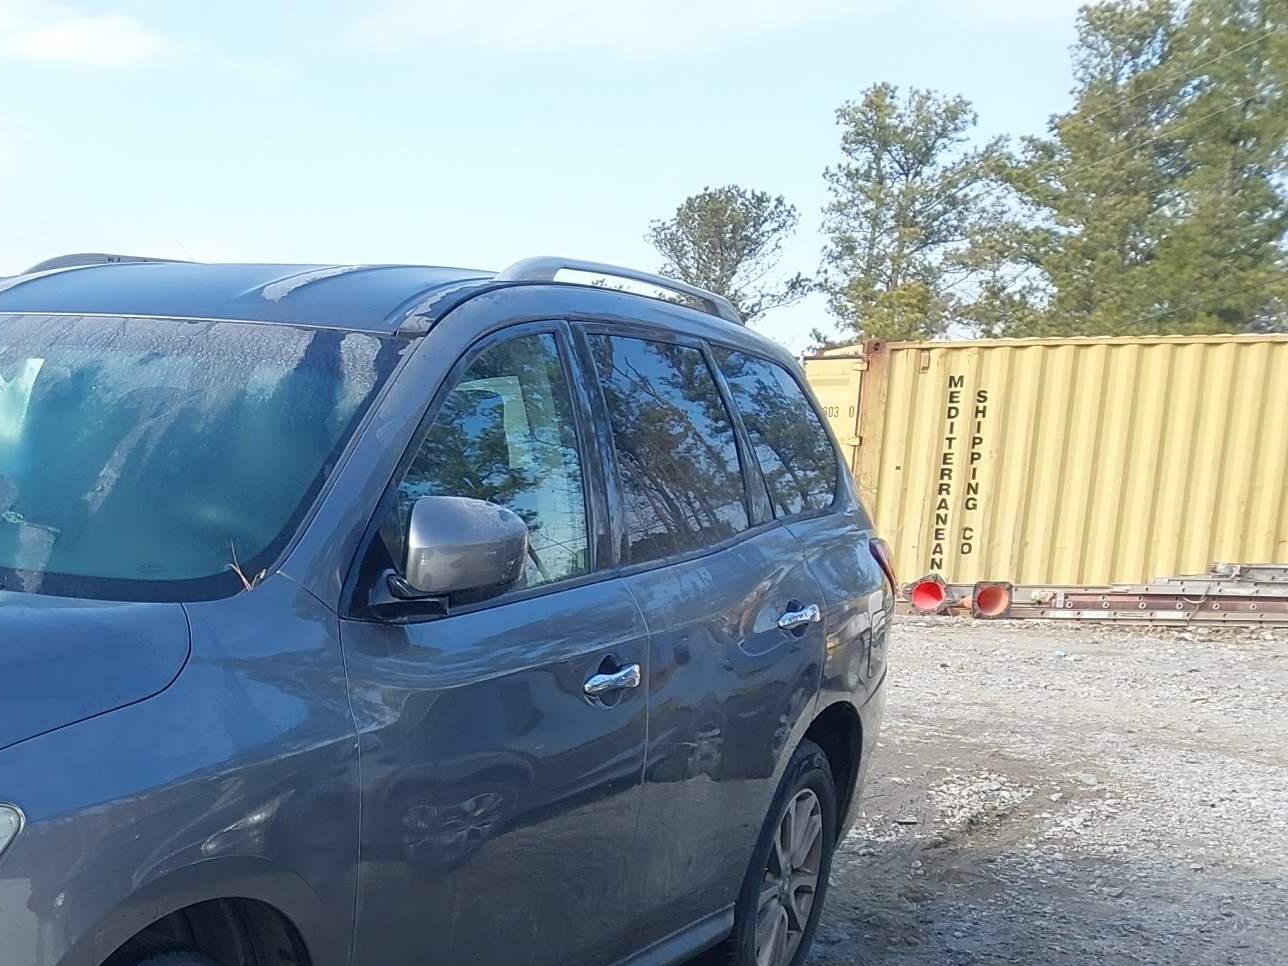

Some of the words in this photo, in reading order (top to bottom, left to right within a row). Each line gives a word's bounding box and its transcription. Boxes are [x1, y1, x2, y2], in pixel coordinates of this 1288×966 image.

[930, 375, 964, 570] MEDITERRANEAN
[965, 390, 988, 511] SHIPPING
[961, 527, 974, 555] CO
